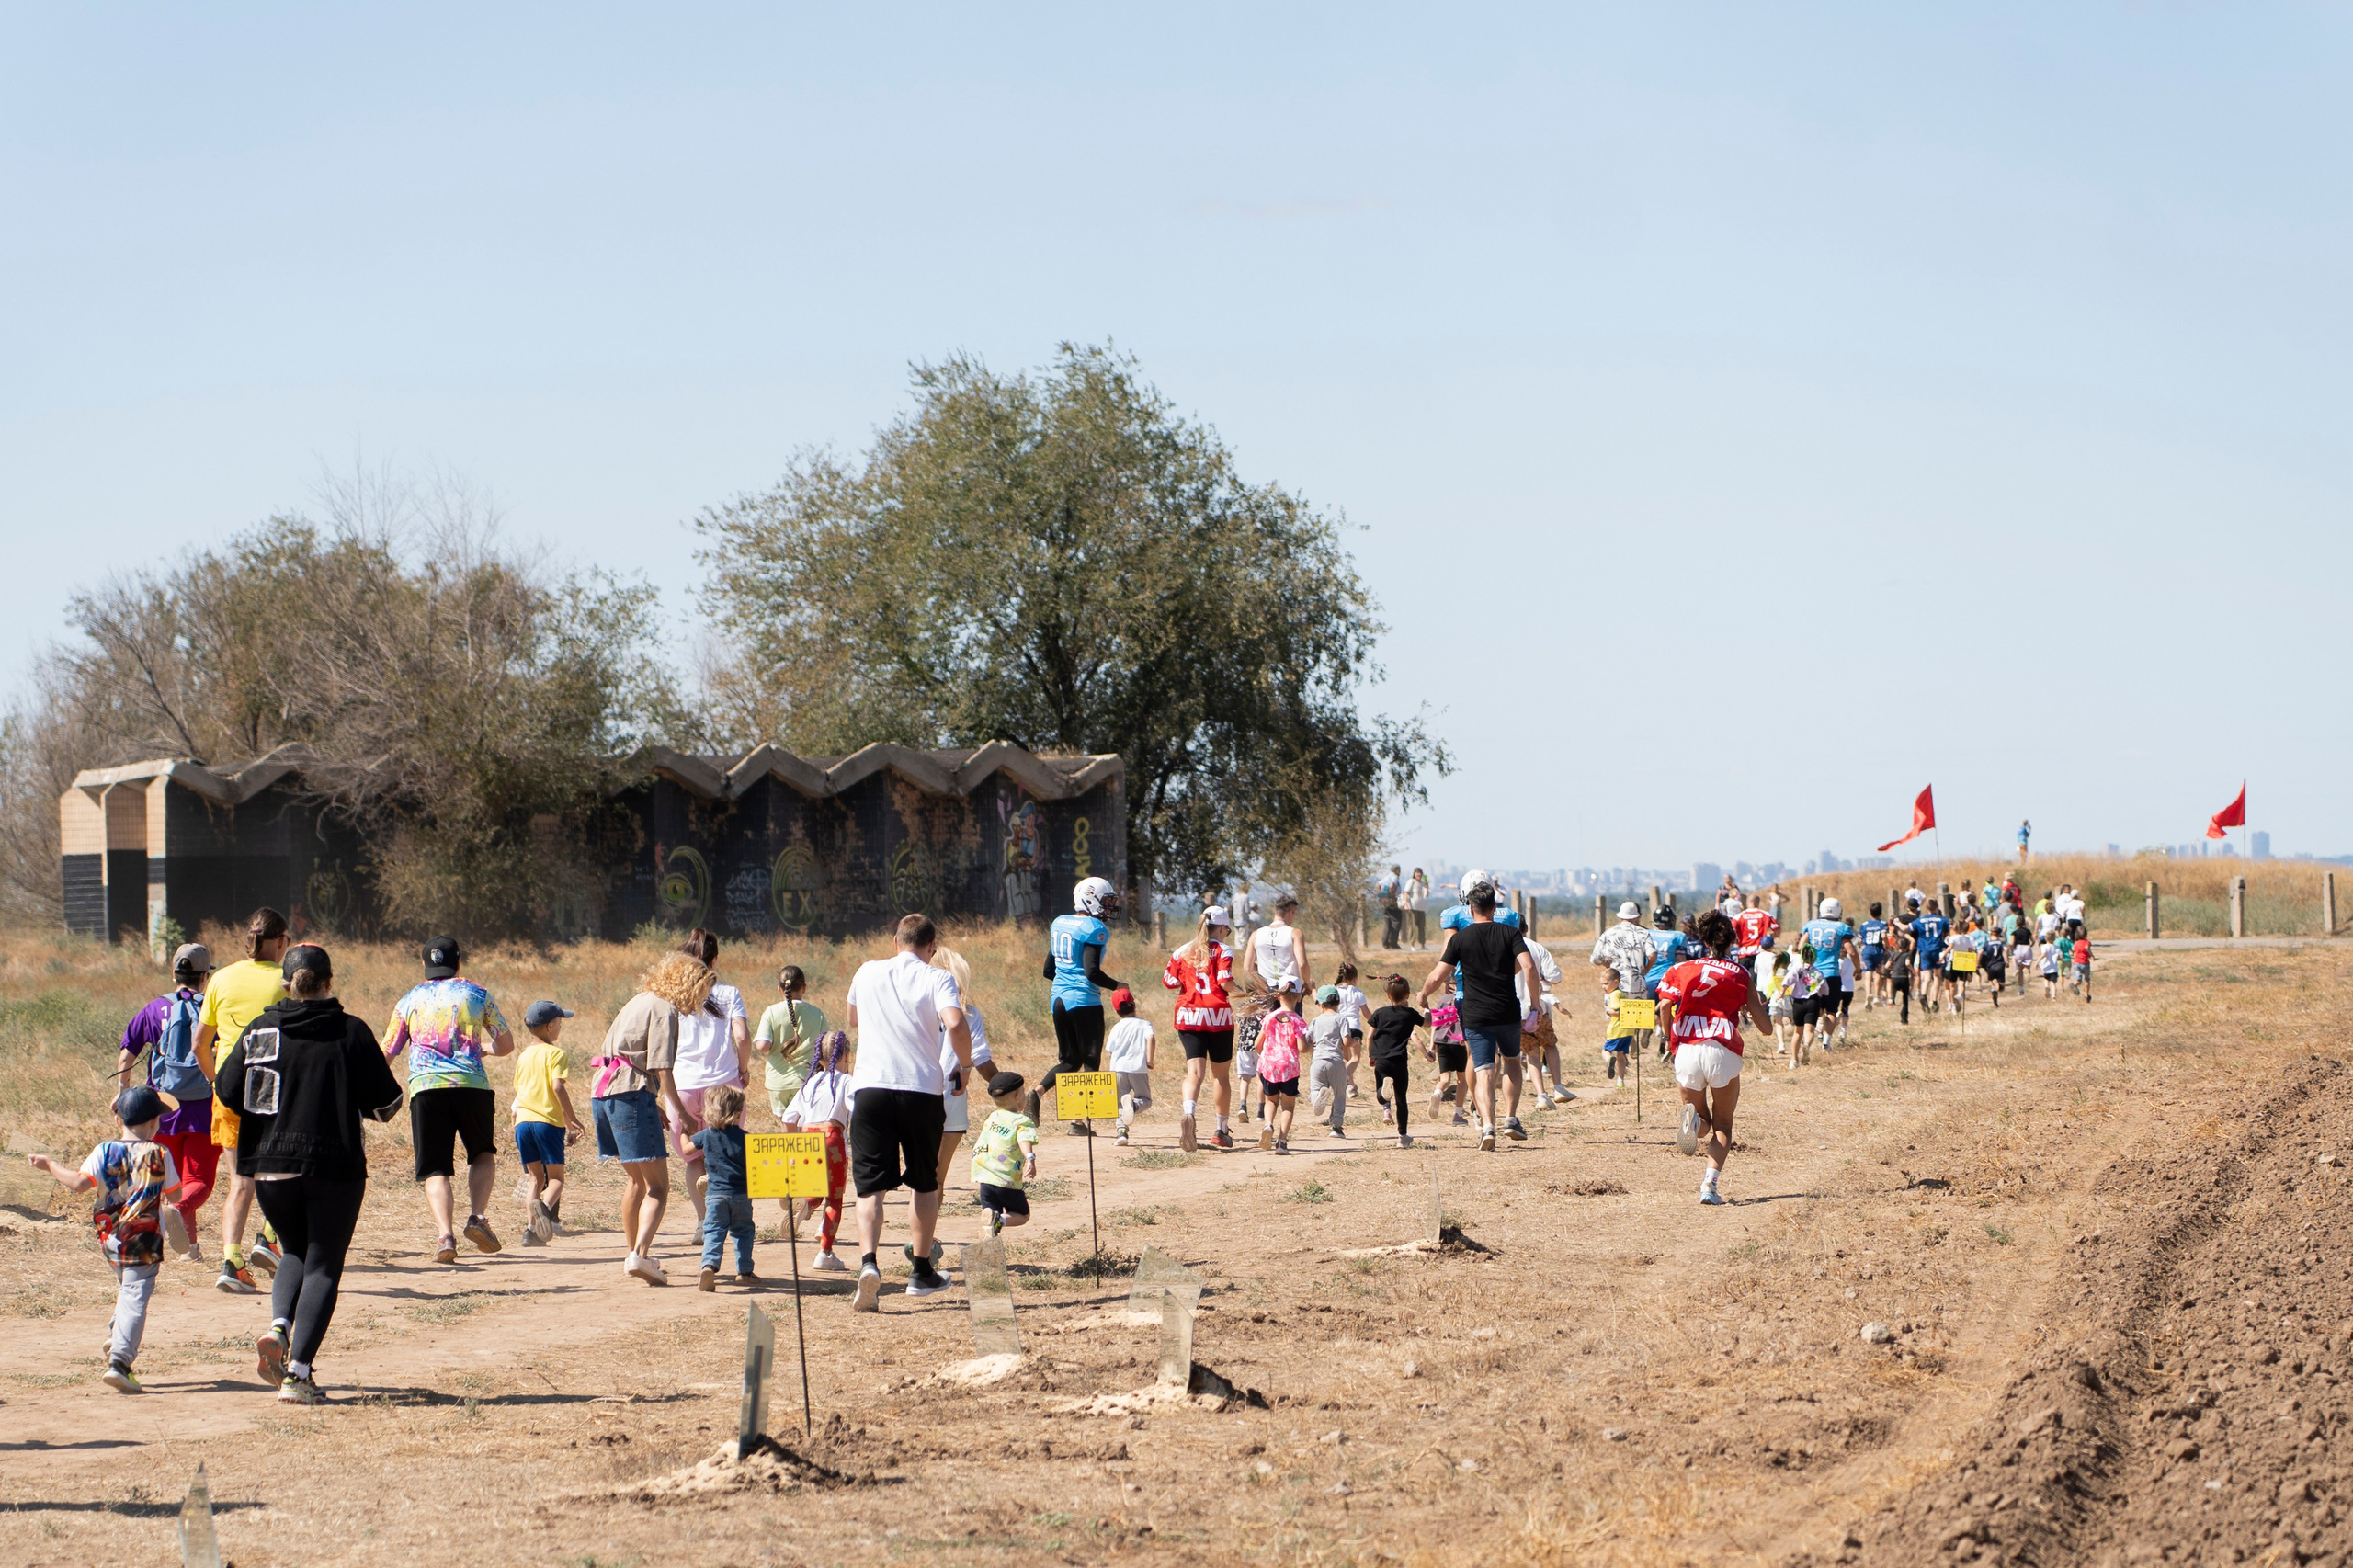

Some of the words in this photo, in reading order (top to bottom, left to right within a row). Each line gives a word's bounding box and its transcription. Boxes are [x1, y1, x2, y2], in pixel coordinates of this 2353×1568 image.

[1747, 919, 1759, 939] 5
[1812, 928, 1836, 948] 83
[1925, 922, 1938, 937] 17
[1052, 930, 1074, 964] 10
[1691, 964, 1725, 998] 5
[1622, 1001, 1653, 1009] ЗАРАЖЕНО
[1061, 1074, 1112, 1087] ЗАРАЖЕНО
[752, 1136, 820, 1153] ЗАРАЖЕНО
